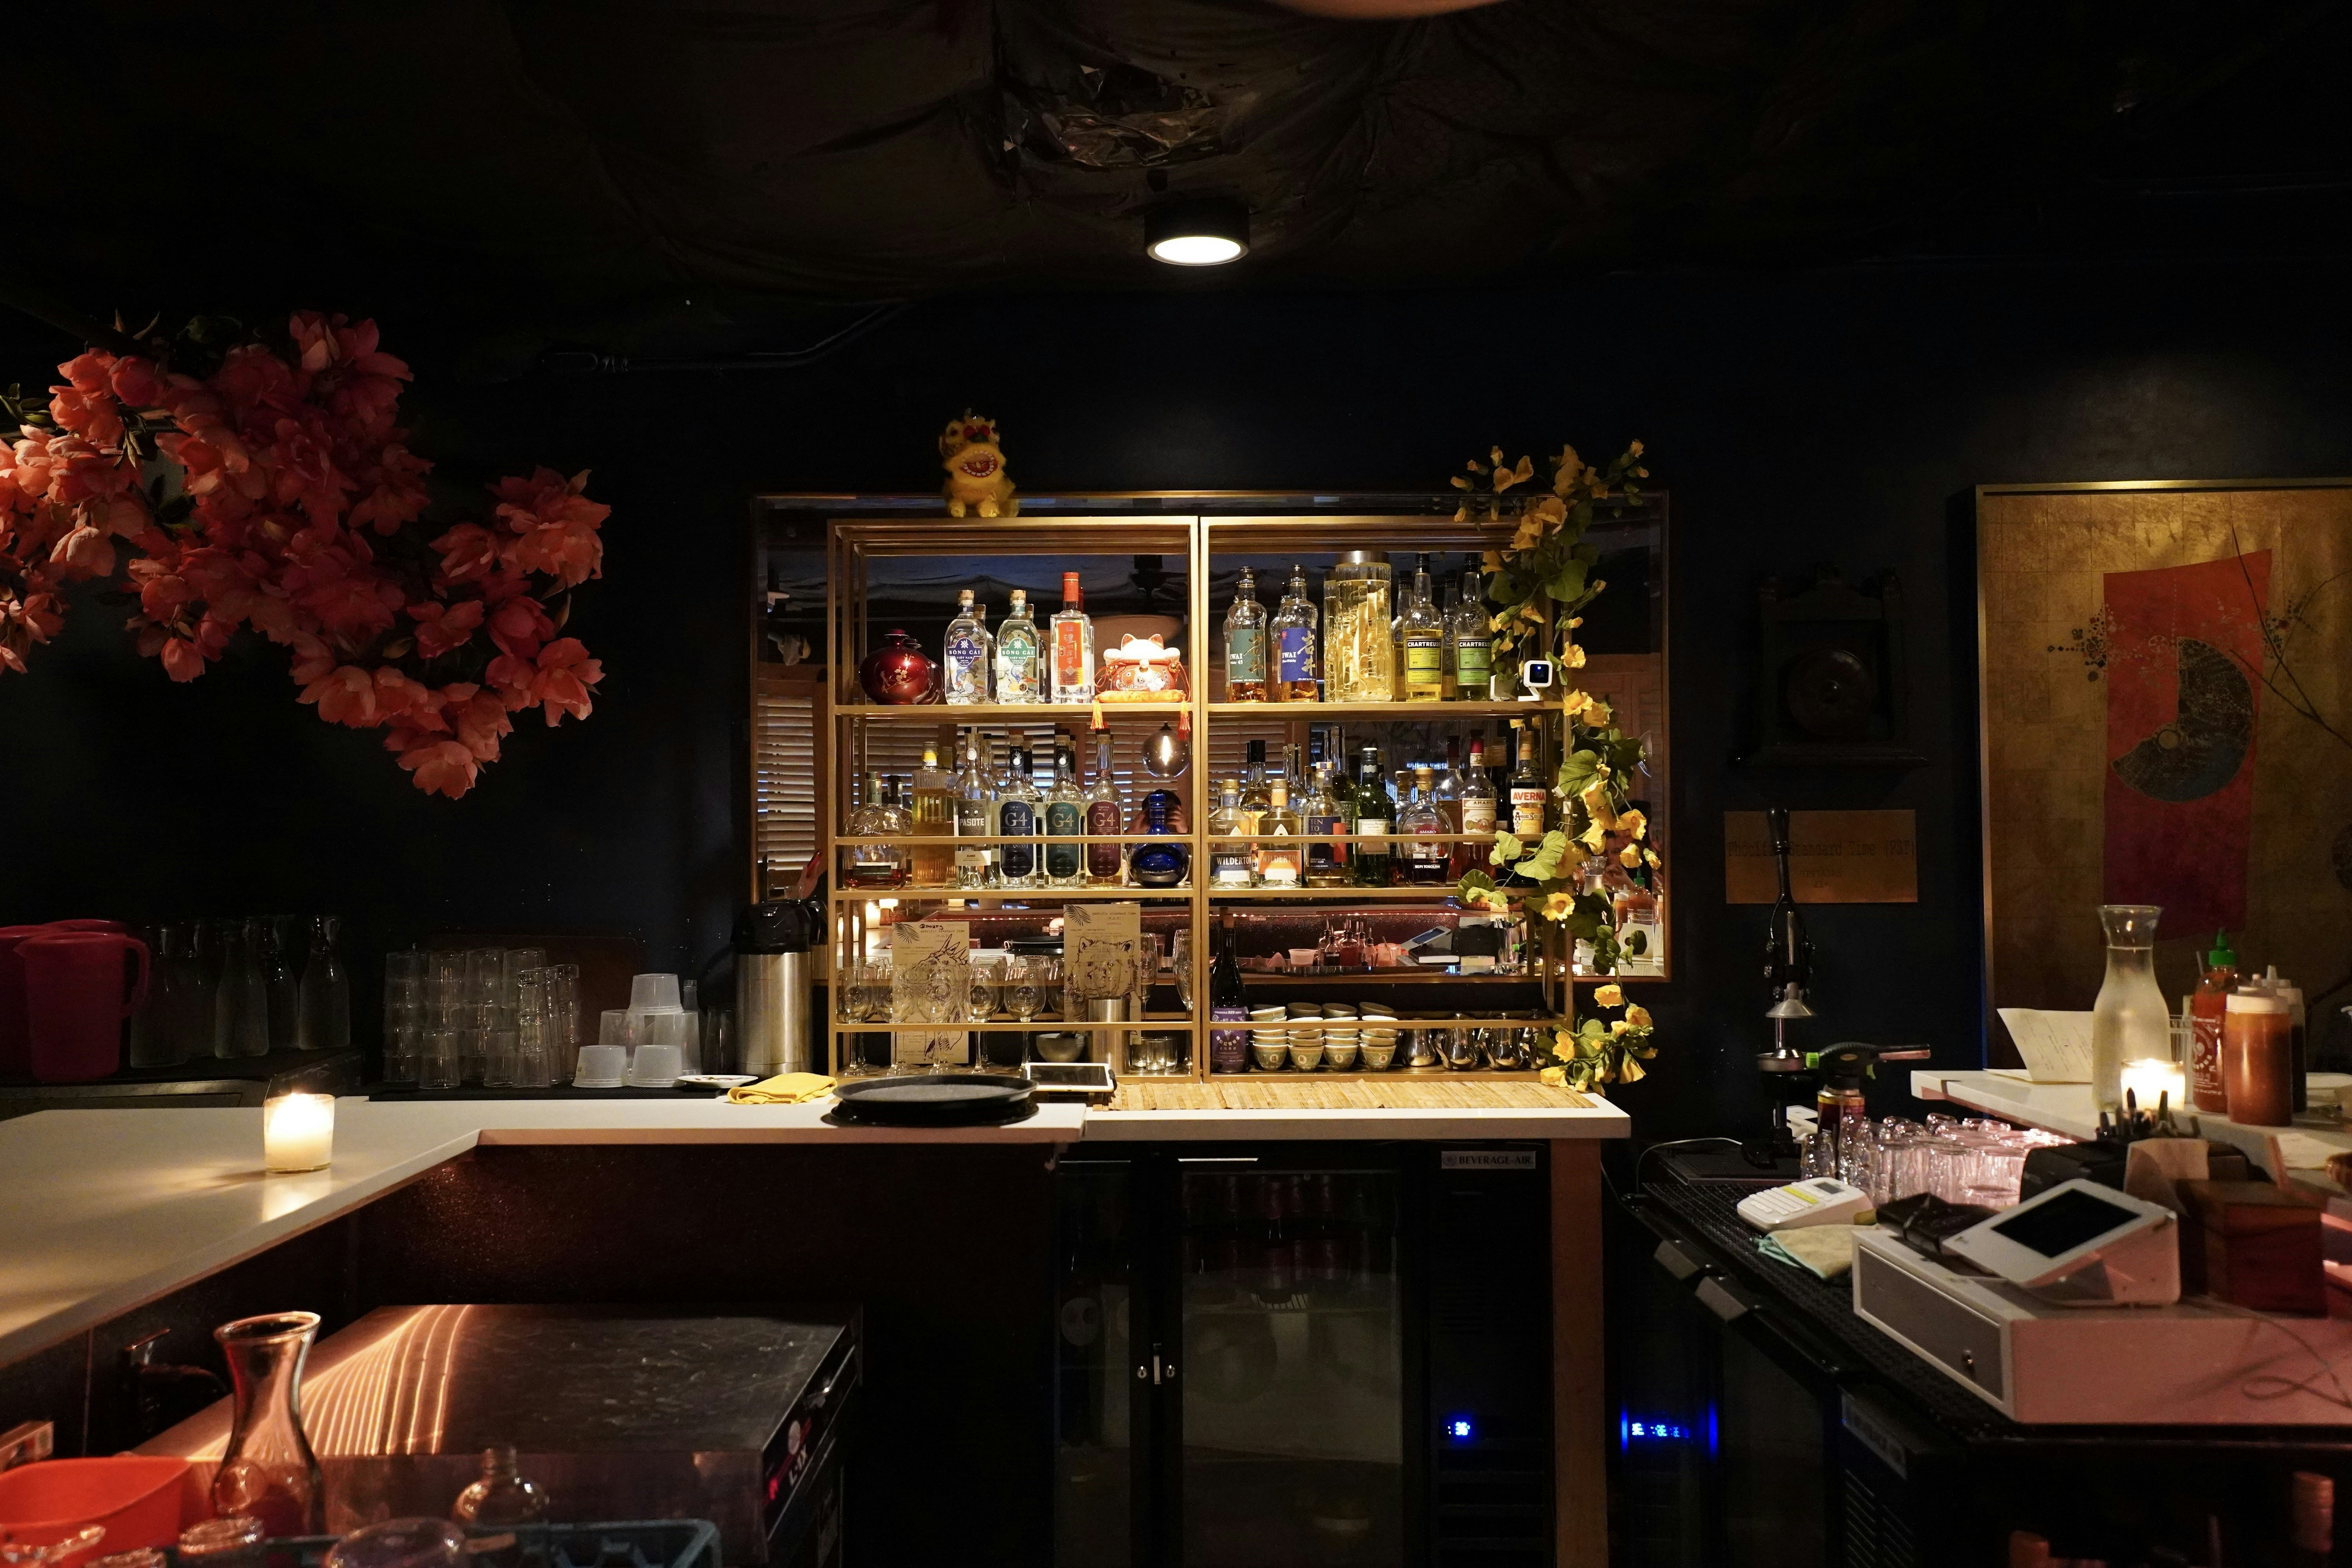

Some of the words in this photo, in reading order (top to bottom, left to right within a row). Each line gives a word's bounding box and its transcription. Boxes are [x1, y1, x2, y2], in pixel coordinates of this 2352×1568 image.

[1513, 792, 1545, 800] AVERNA
[960, 818, 984, 826] PASOTE
[1005, 811, 1027, 827] G4
[1052, 813, 1074, 828] G4
[1093, 812, 1116, 827] G4
[1786, 841, 1844, 857] Standard
[1849, 842, 1877, 856] Time
[1886, 840, 1914, 857] (PST)
[1216, 857, 1252, 865] WILDERTON
[1263, 855, 1299, 863] WILDERTON
[1459, 1155, 1531, 1164] BEVERAGE-AIR
